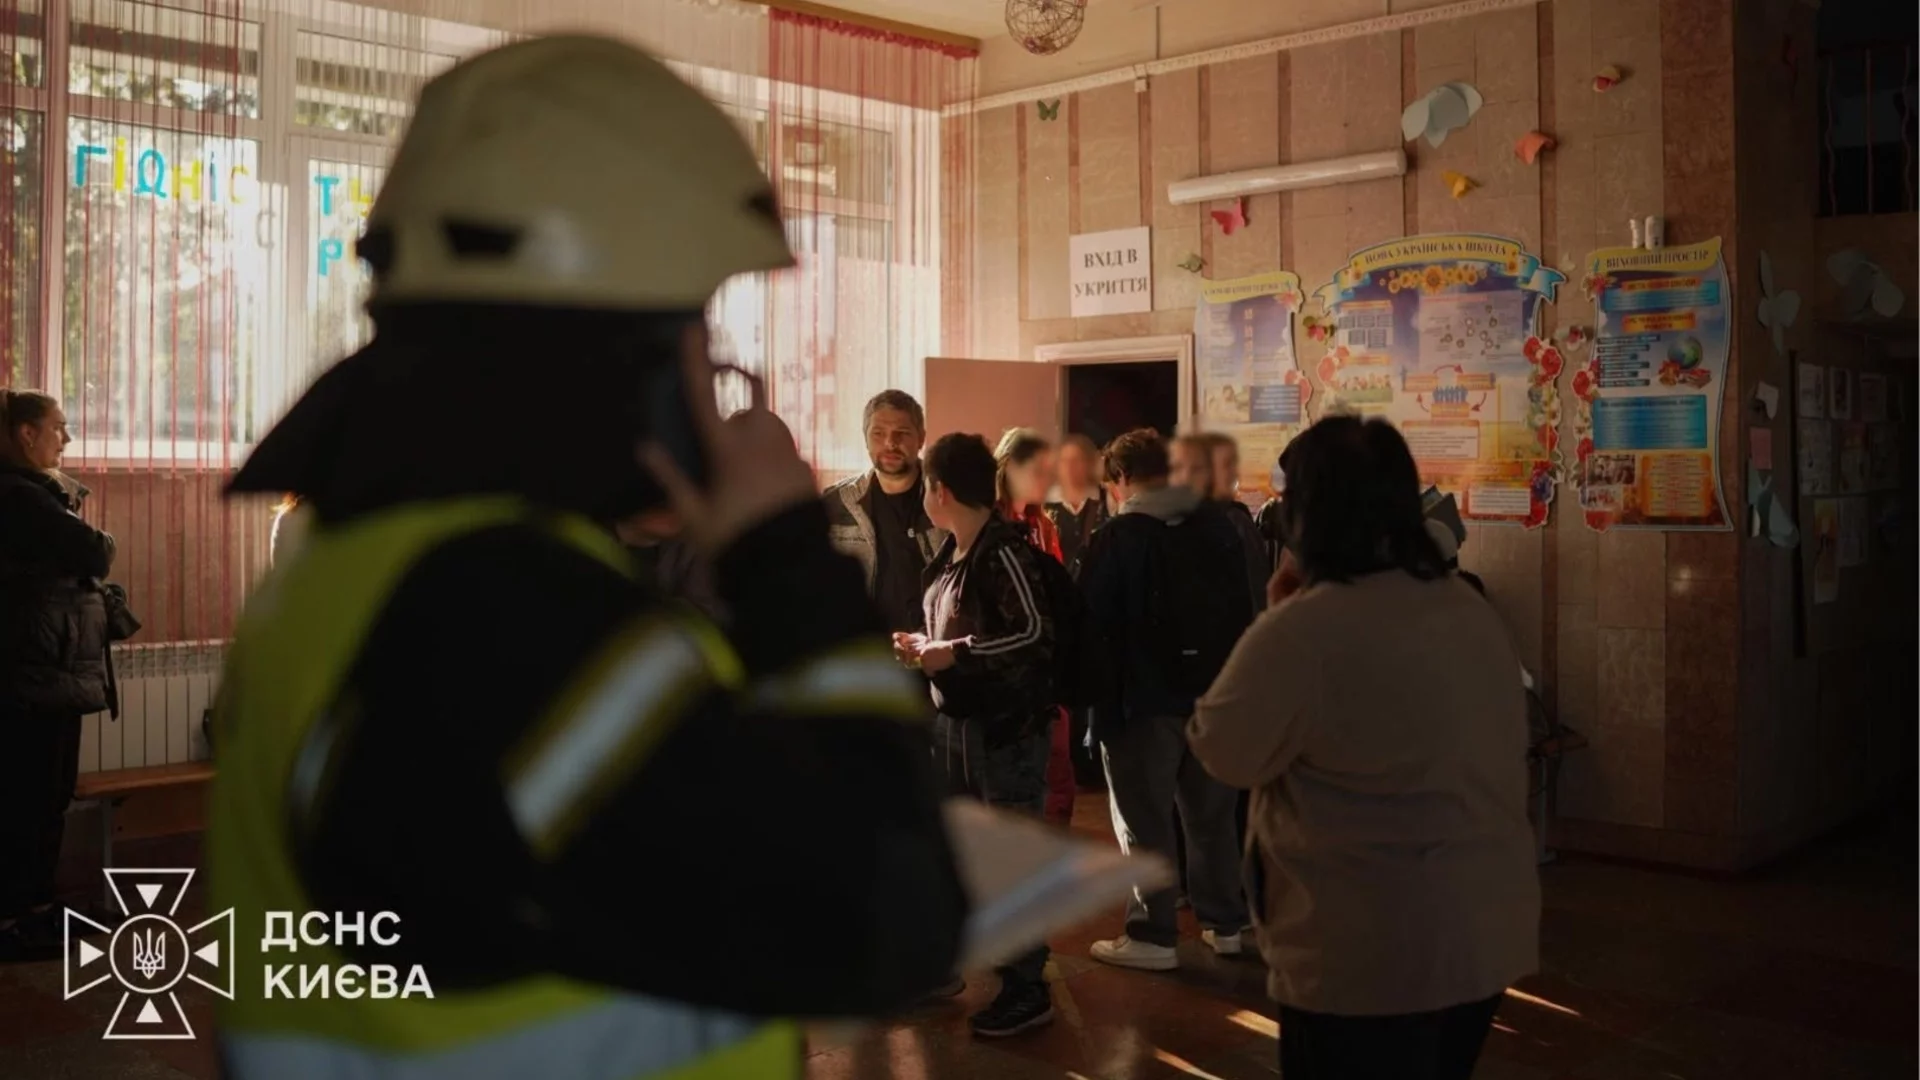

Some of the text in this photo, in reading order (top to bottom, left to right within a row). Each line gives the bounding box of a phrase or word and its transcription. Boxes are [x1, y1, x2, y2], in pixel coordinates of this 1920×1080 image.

[1083, 248, 1138, 269] ВХІД В
[1074, 276, 1148, 298] УКРИТТЯ
